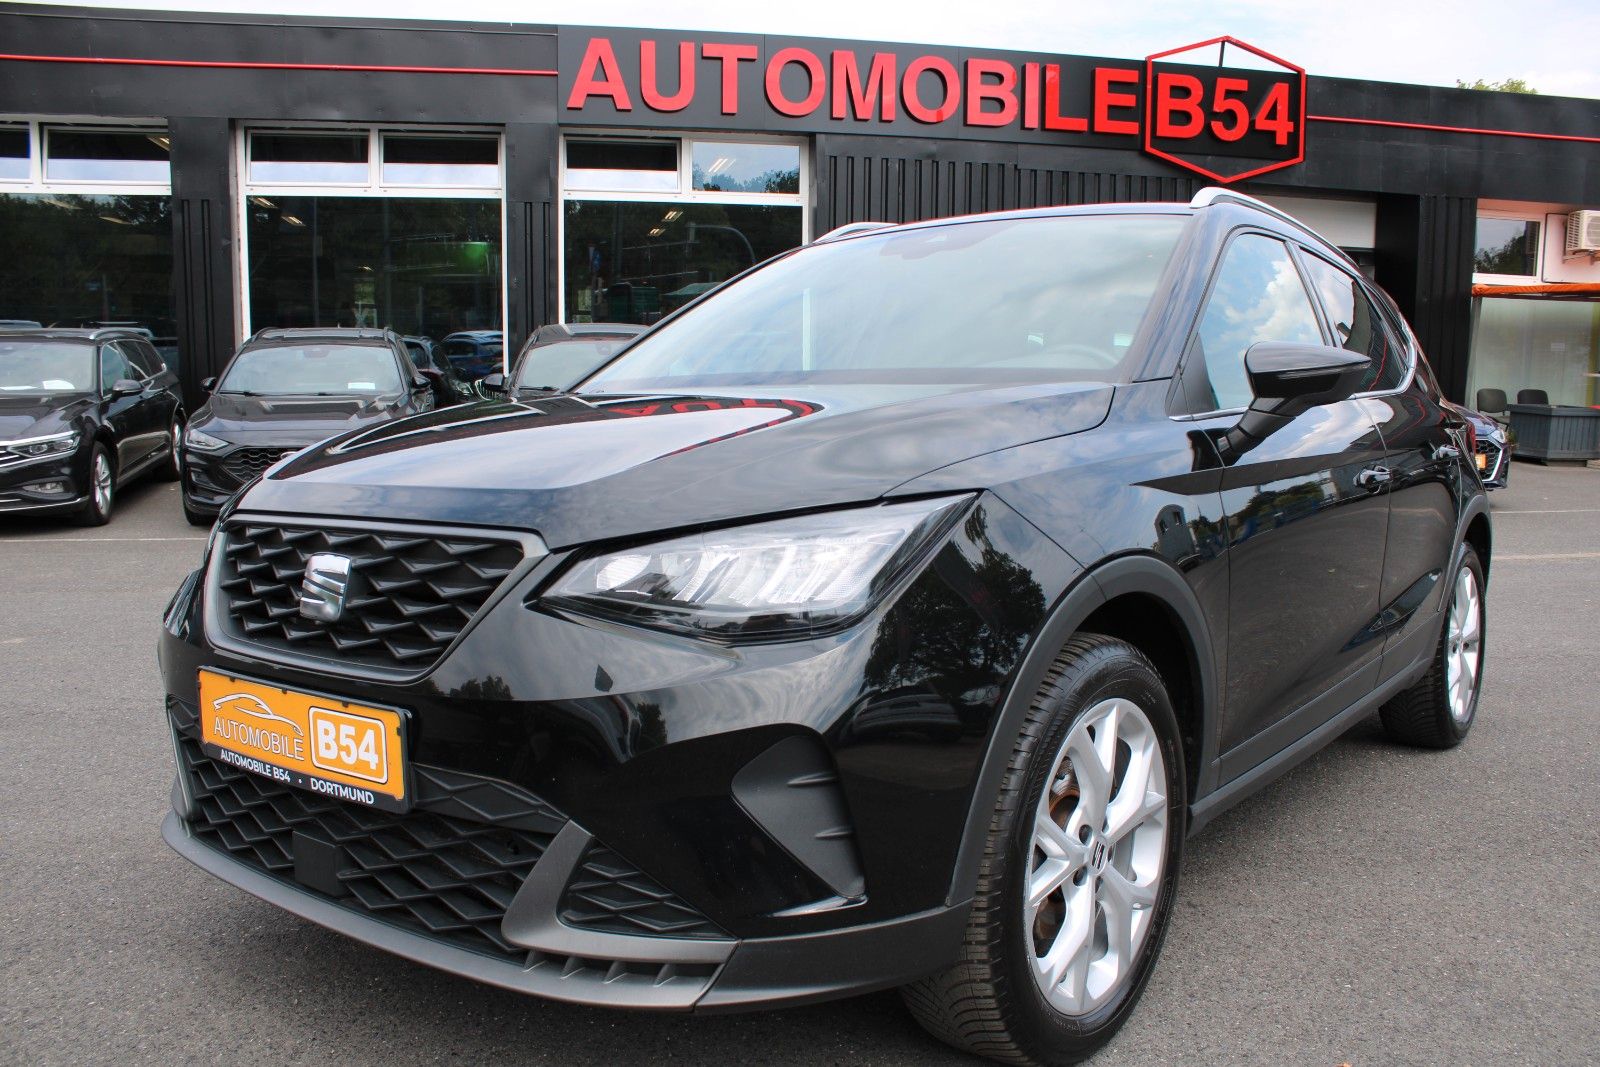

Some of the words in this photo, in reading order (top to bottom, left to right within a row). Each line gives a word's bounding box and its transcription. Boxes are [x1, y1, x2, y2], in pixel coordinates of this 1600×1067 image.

[566, 37, 1140, 136] AUTOMOBILE
[1155, 73, 1294, 146] B54
[213, 716, 304, 761] AUTOMOBILE
[316, 719, 379, 770] B54
[220, 748, 272, 777] AUTOMOBILE
[273, 766, 291, 783] B54
[310, 777, 375, 805] DORTMUND
